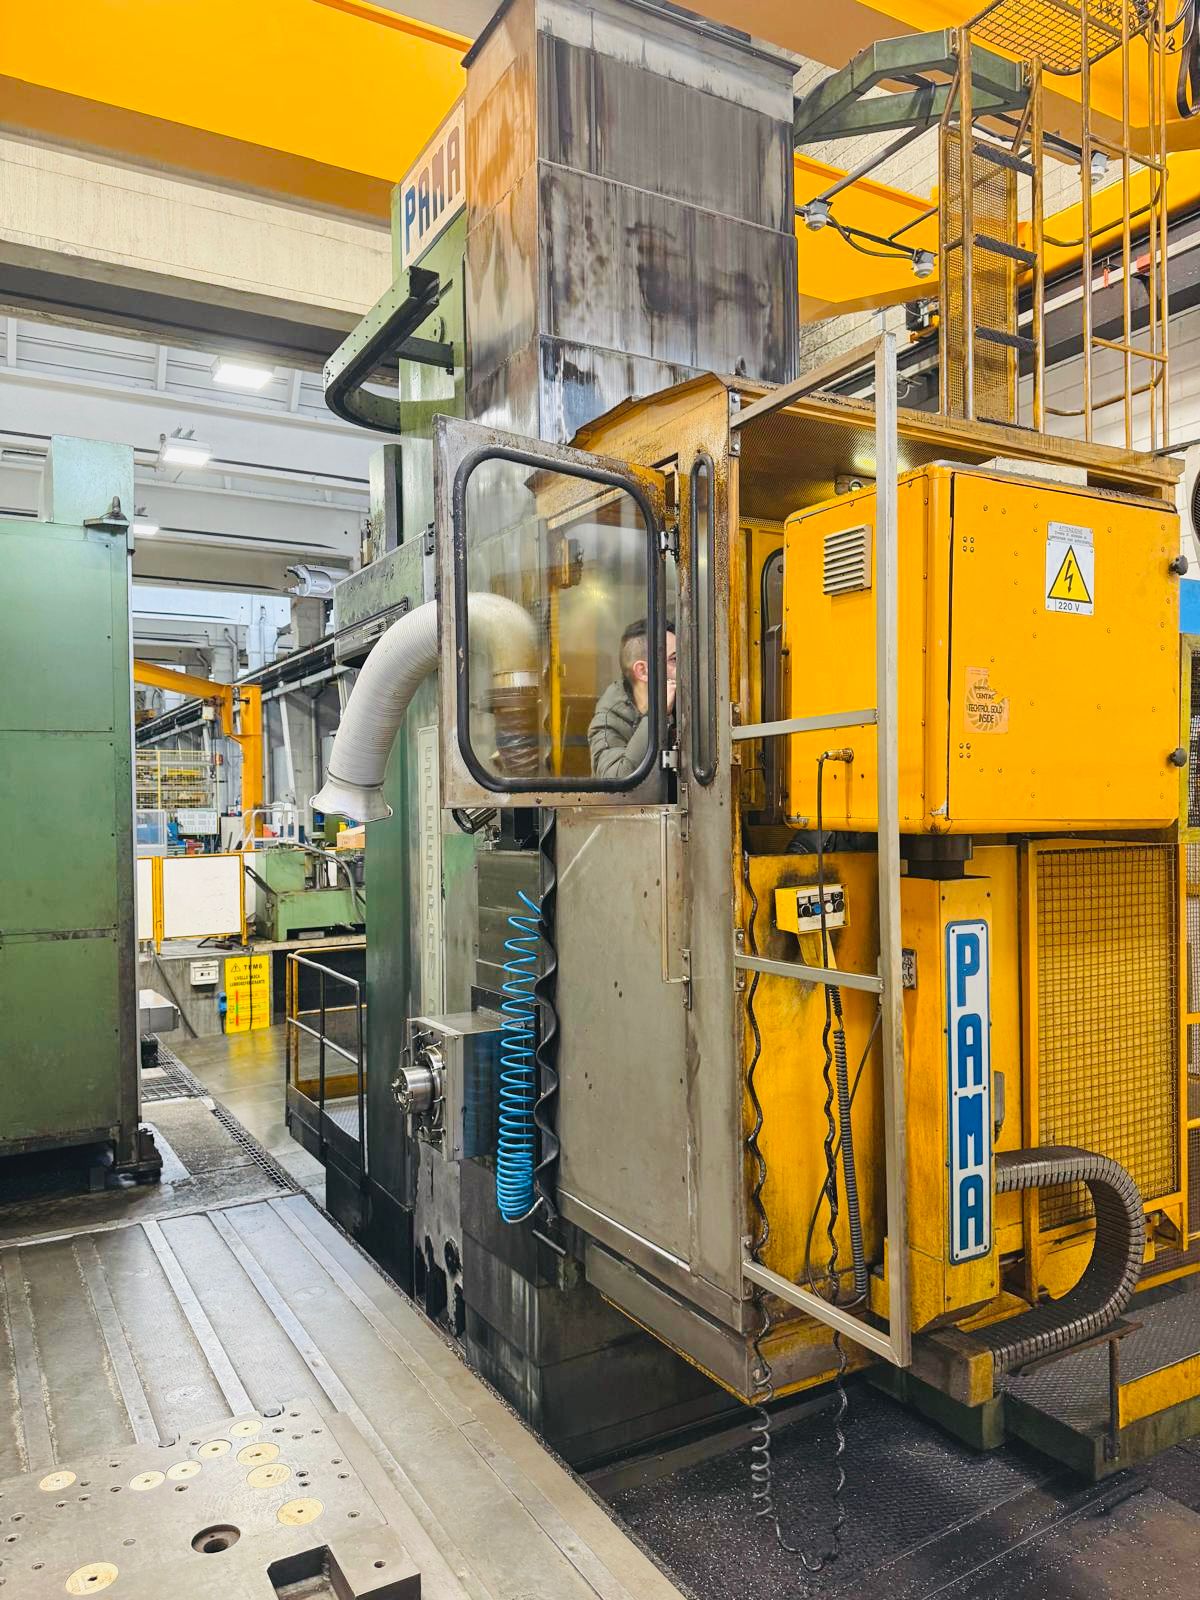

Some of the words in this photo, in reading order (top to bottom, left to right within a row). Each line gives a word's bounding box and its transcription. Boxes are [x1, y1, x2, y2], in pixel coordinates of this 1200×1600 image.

[405, 126, 460, 256] PAMA
[1058, 602, 1073, 611] 220
[1075, 603, 1080, 612] V
[979, 714, 995, 723] INSIDE
[991, 706, 1002, 714] GOLD
[424, 746, 436, 980] SPEEDRAM
[956, 932, 984, 1251] PAMA
